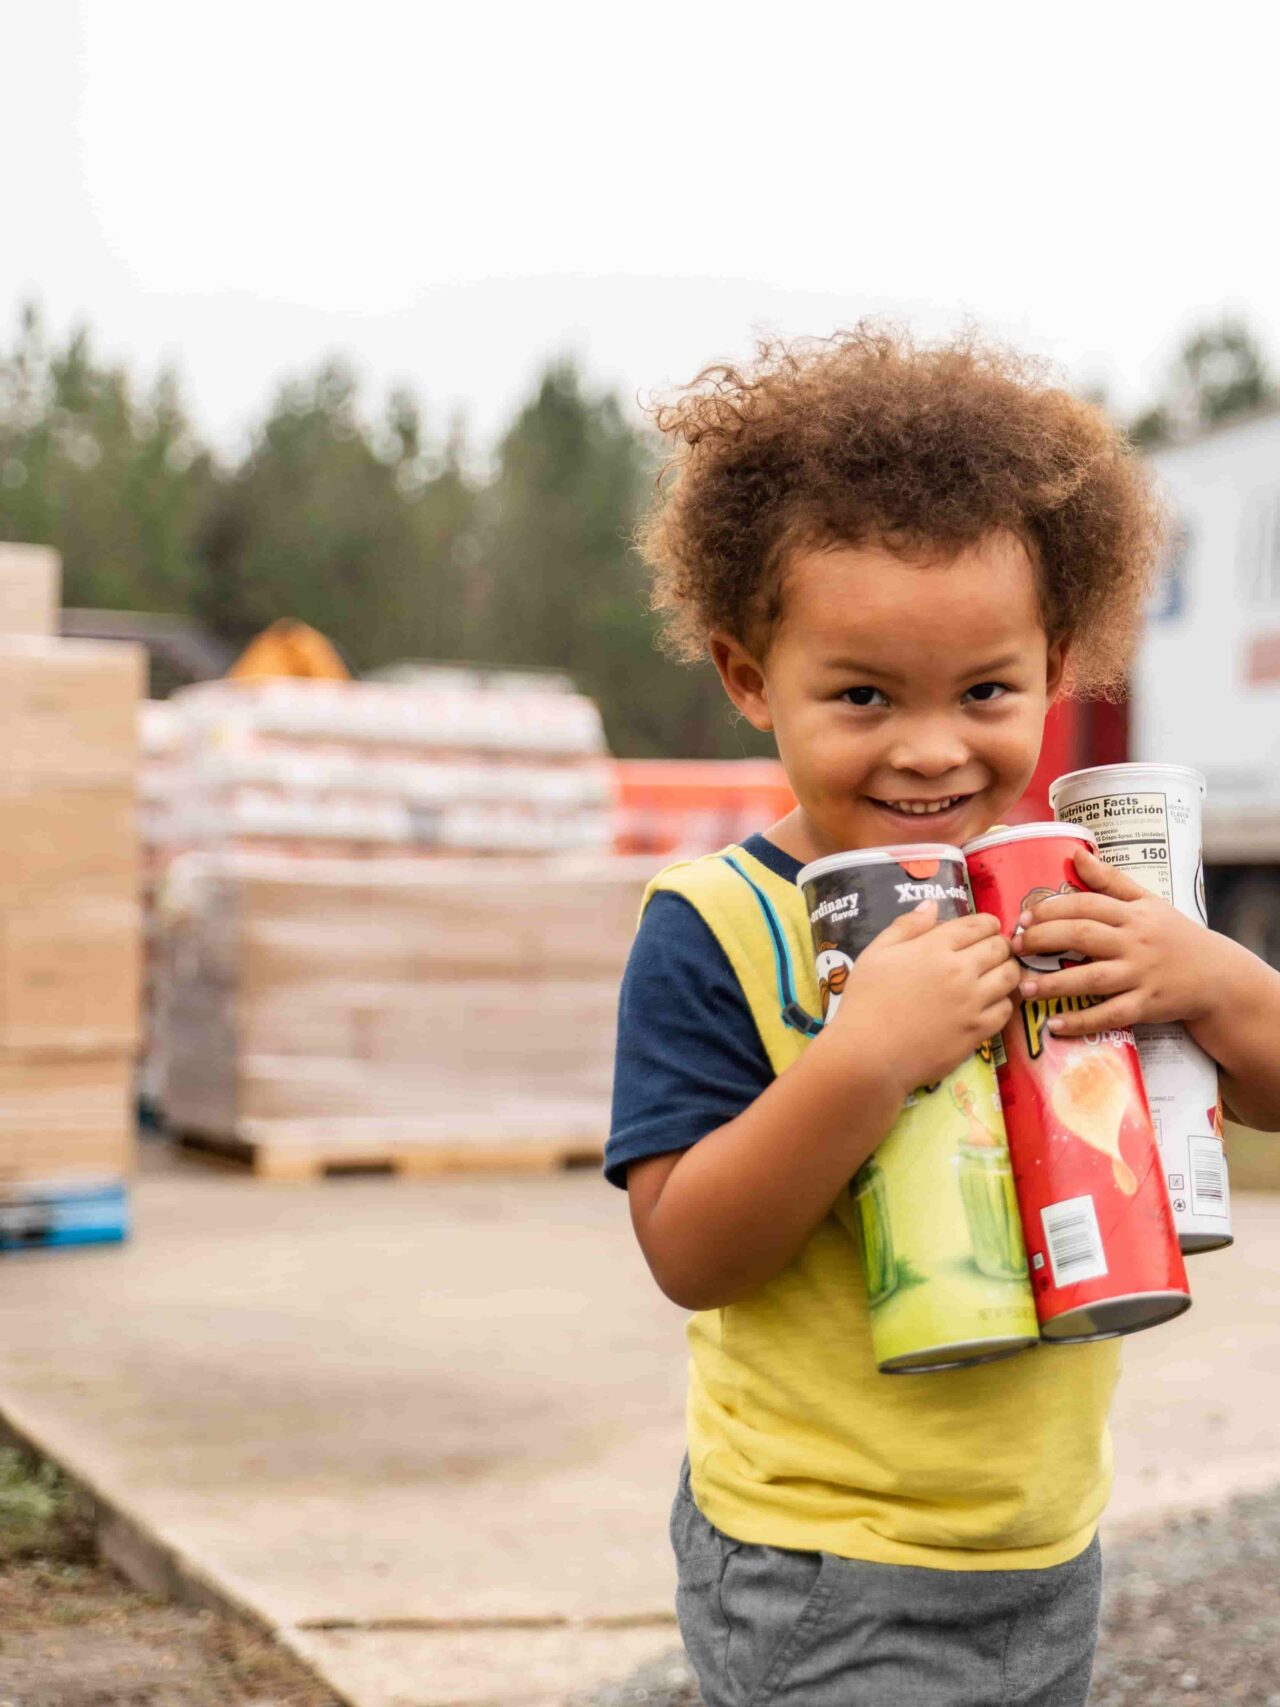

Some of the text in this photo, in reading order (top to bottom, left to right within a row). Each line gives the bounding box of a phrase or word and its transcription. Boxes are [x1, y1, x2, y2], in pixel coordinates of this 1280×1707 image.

[1060, 797, 1138, 820] Nutrition Facts
[1086, 812, 1100, 821] de
[1103, 805, 1163, 818] Nutrición
[1141, 847, 1167, 860] 150
[831, 907, 860, 923] flavor
